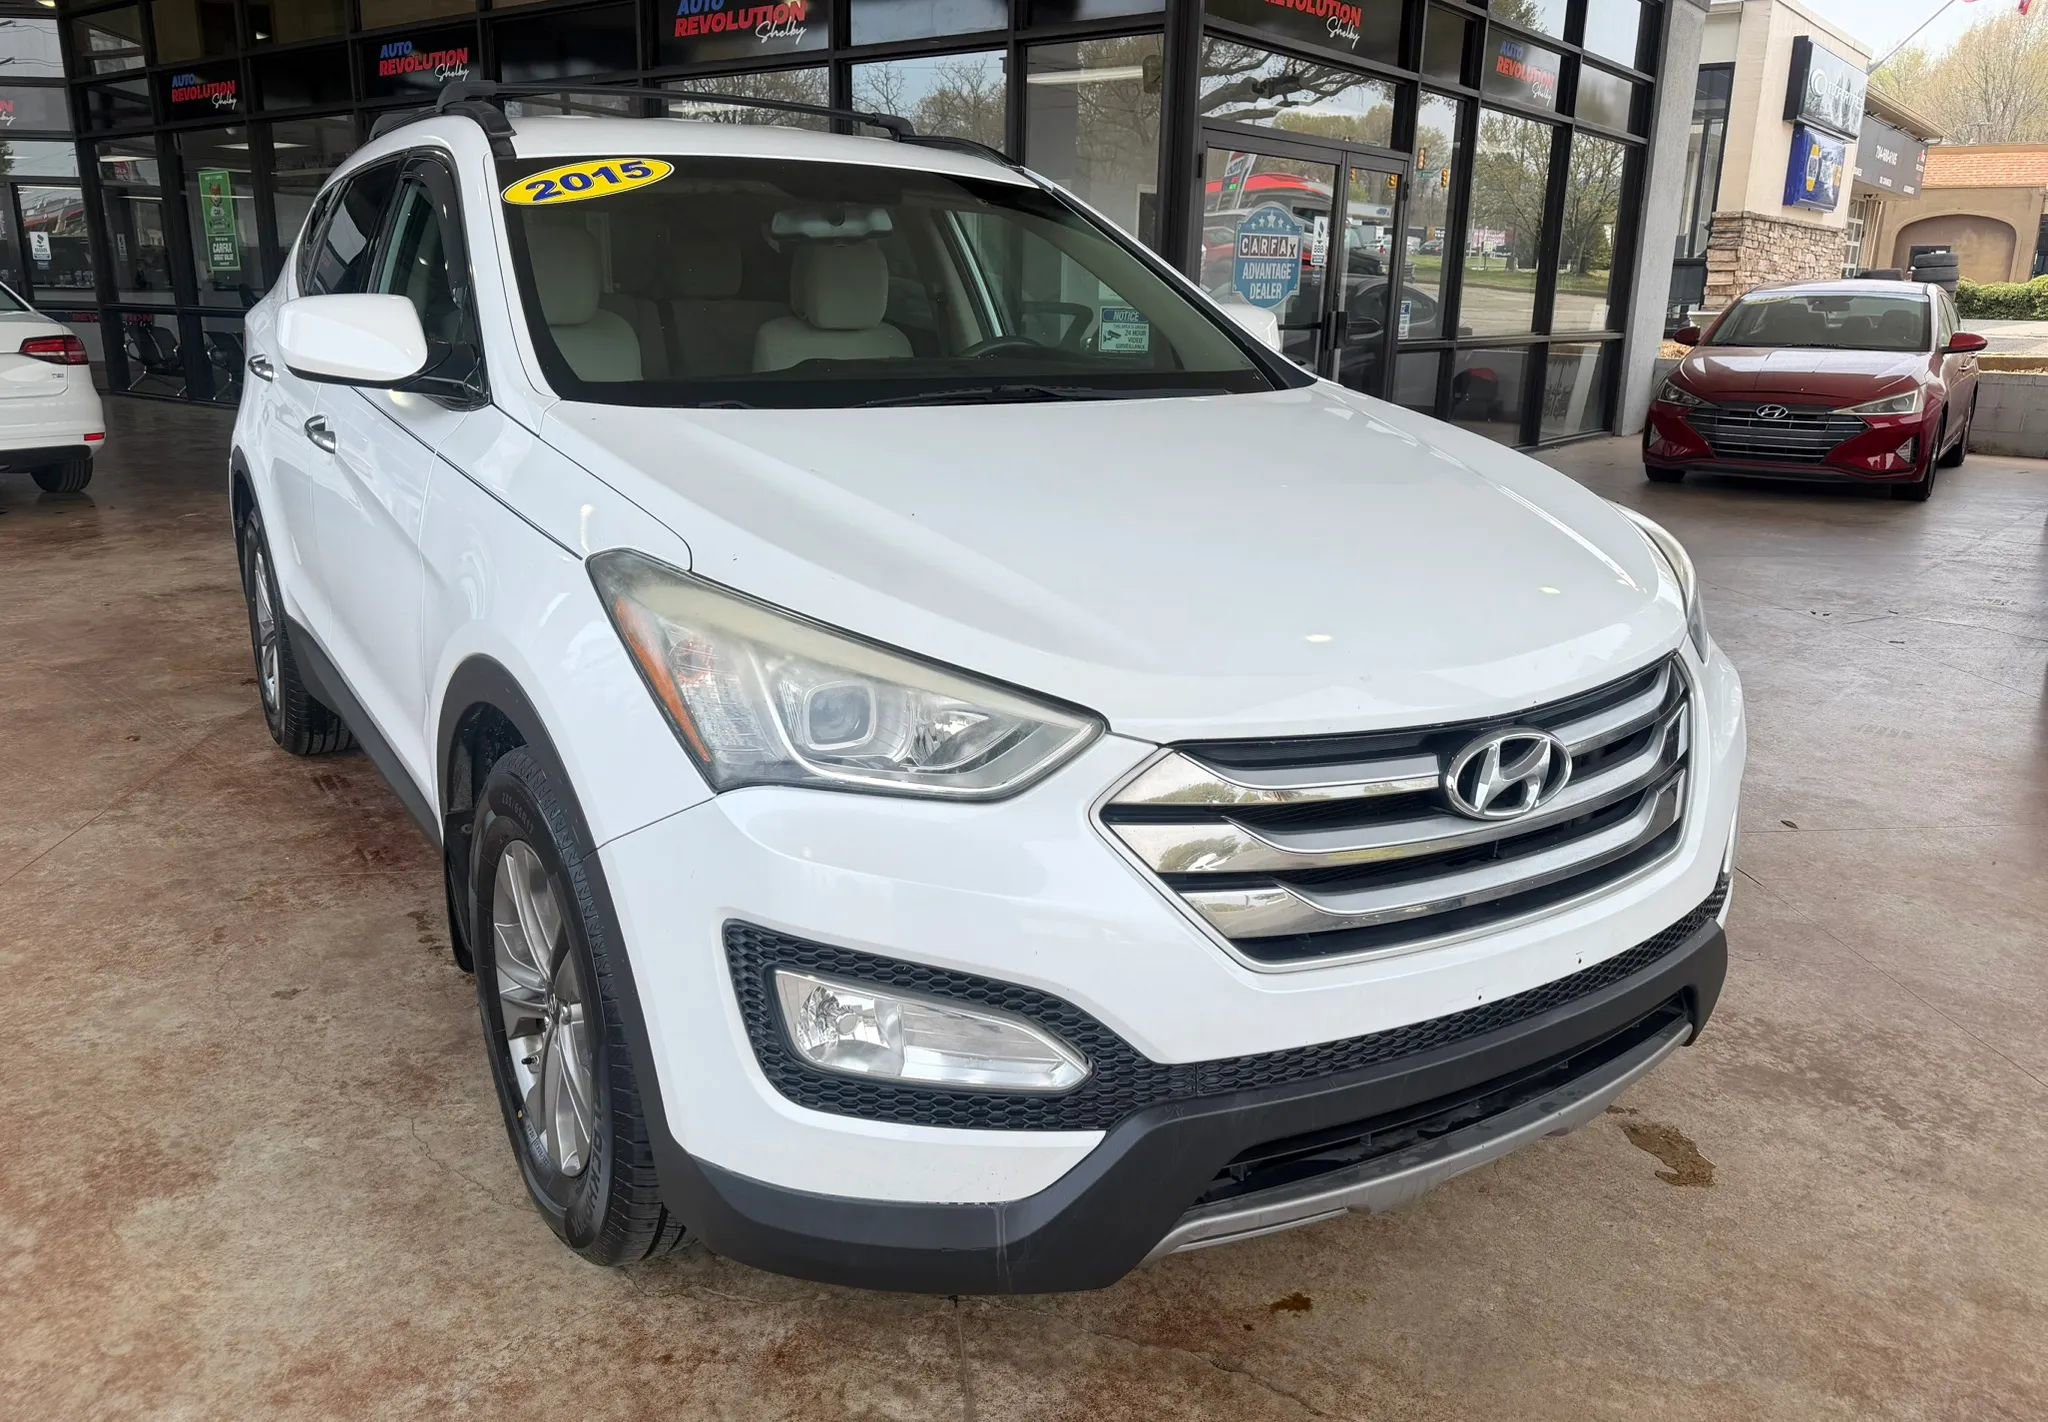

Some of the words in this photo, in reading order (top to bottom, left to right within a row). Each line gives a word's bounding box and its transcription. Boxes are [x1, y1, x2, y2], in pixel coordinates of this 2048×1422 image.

[675, 1, 808, 37] REVOLUTION
[755, 16, 807, 45] Shelby
[1326, 16, 1361, 50] Shelby
[380, 41, 413, 58] AUTO
[1500, 40, 1524, 60] AUTO
[379, 47, 469, 77] REVOLUTION
[434, 60, 470, 82] Shelby
[1496, 55, 1555, 91] REVOLUTION
[171, 80, 236, 103] REVOLUTION
[172, 73, 195, 88] AUTO
[211, 90, 238, 110] Shelby
[525, 160, 655, 201] 2015
[212, 242, 233, 255] CARFAX
[1240, 236, 1297, 258] CARFAX
[1242, 262, 1292, 280] ADVANTAGE
[1249, 282, 1282, 300] DEALER
[1113, 311, 1140, 322] NOTICE
